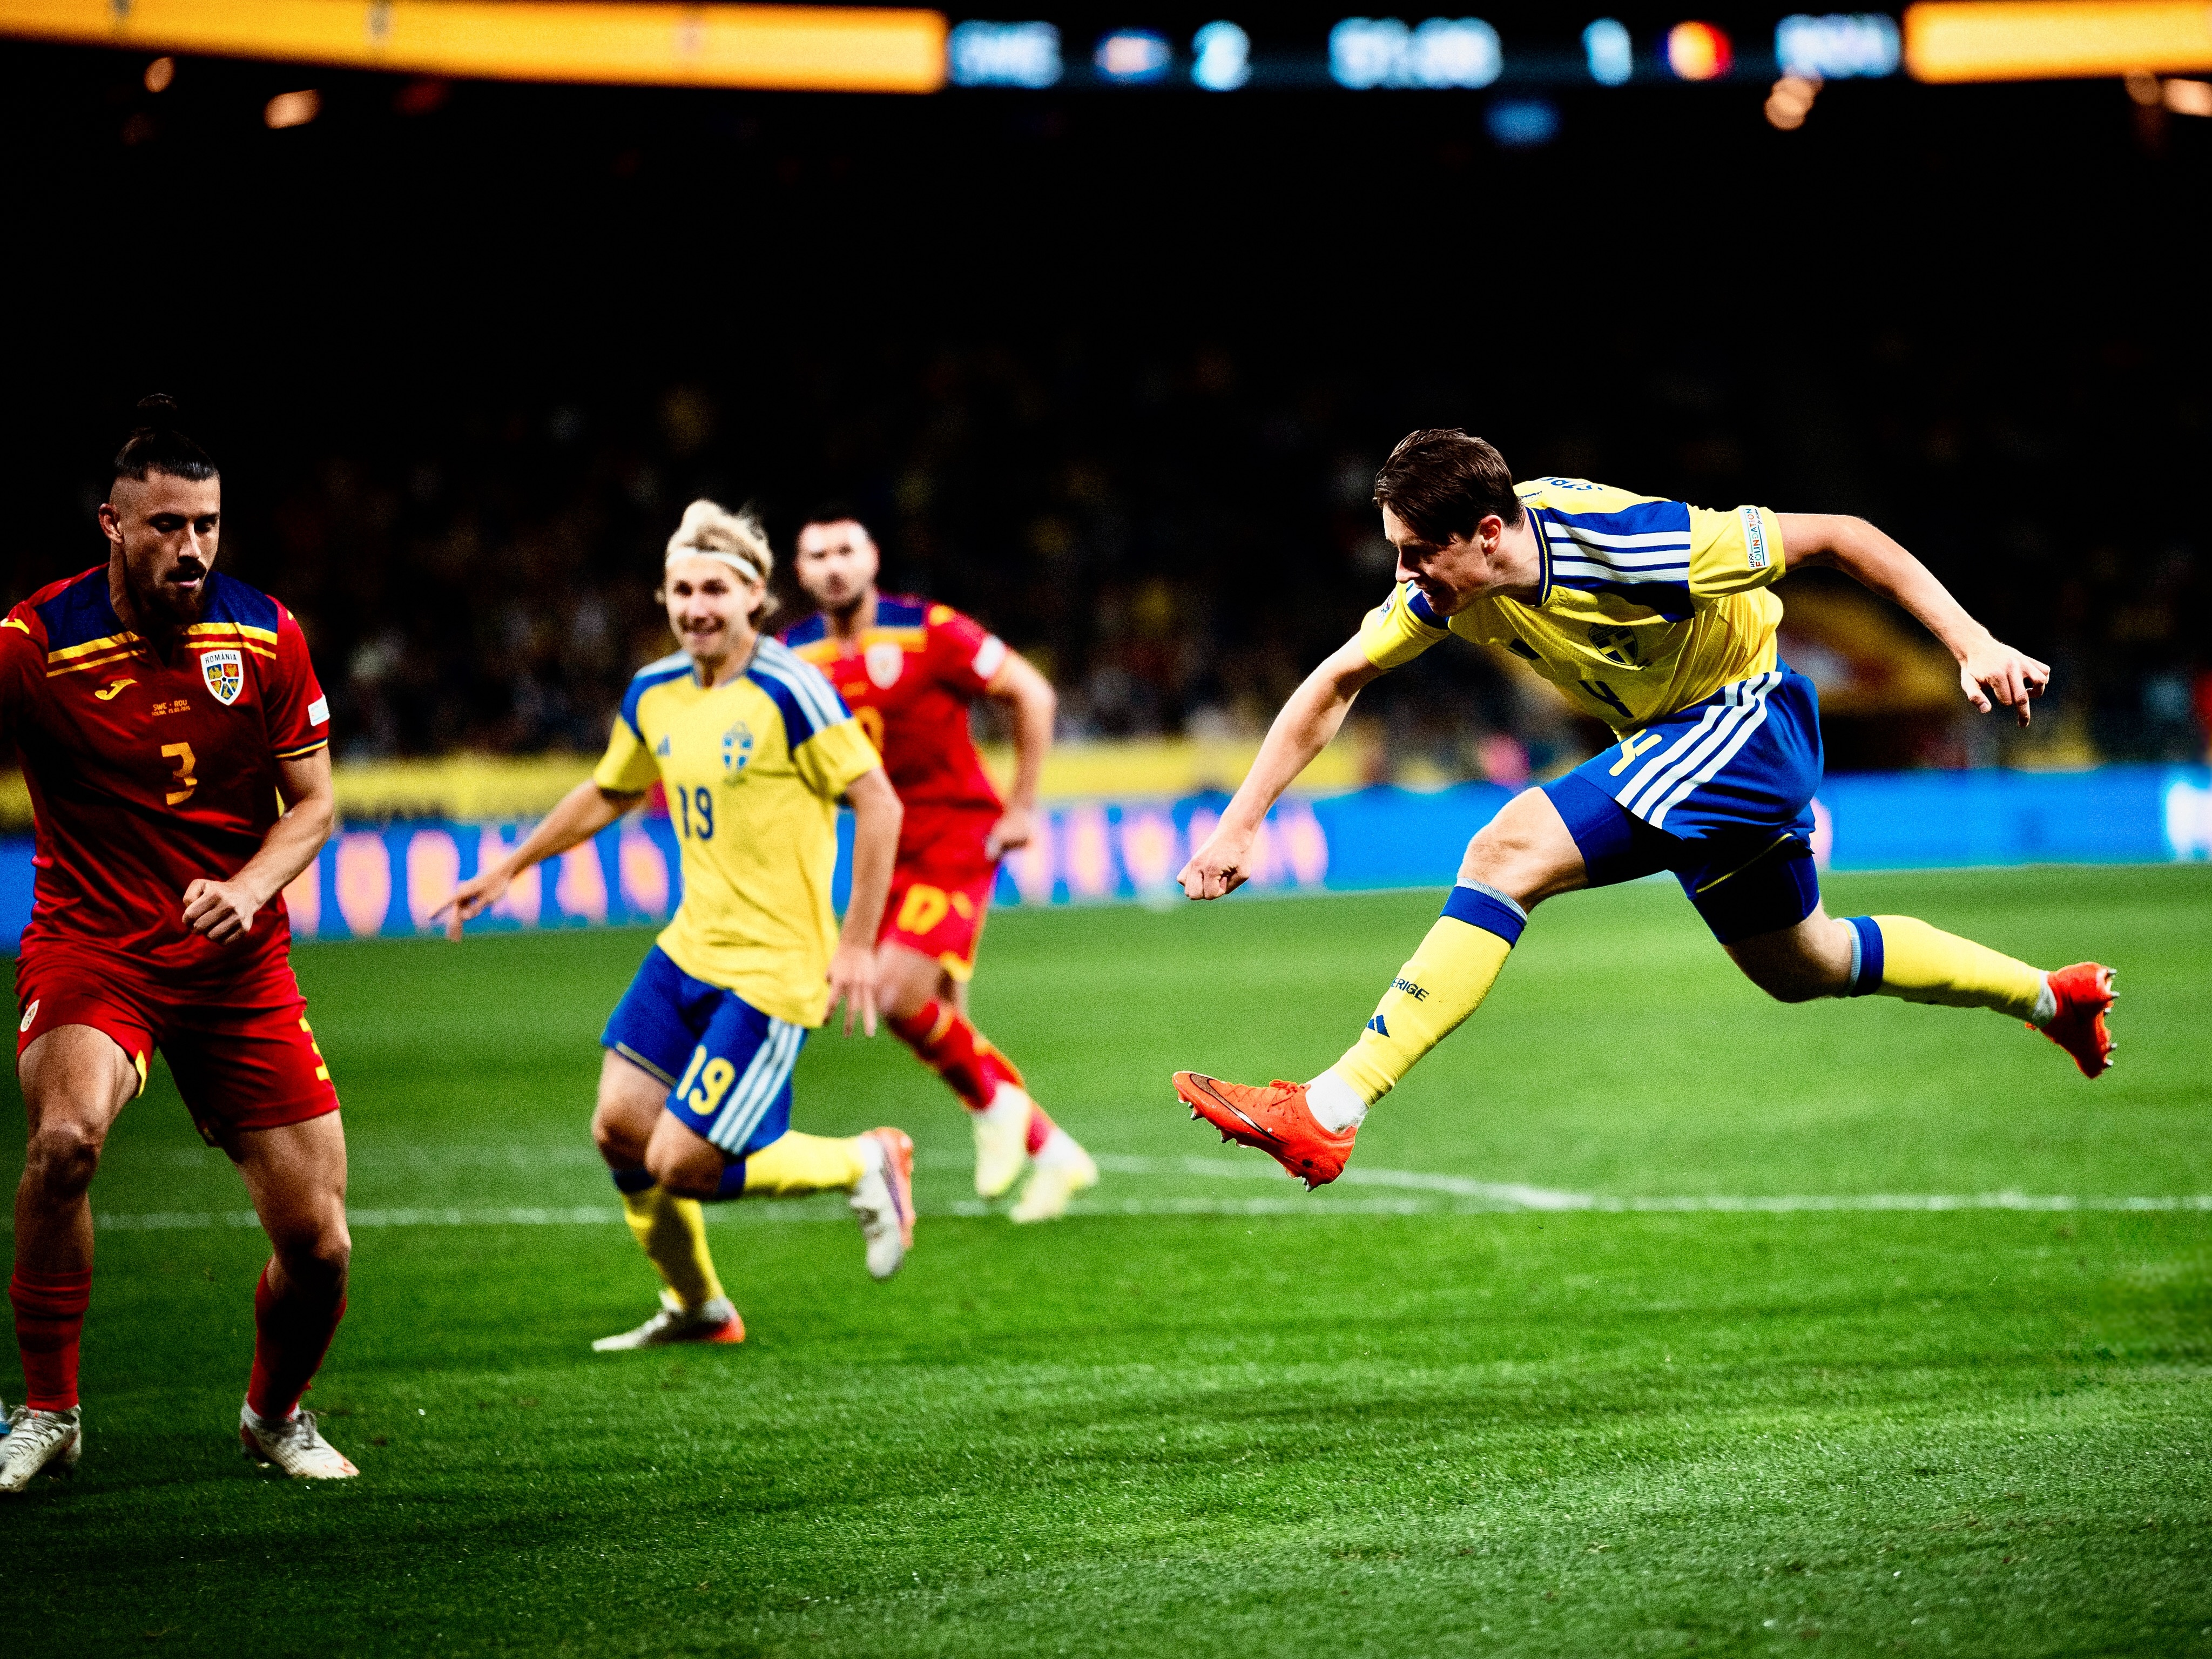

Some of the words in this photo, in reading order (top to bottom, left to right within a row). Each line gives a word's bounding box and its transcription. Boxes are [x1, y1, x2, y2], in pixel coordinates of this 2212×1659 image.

[1745, 509, 1763, 567] FOUNDATION
[1577, 680, 1634, 718] 4
[161, 743, 197, 805] 3
[1609, 729, 1662, 776] 4
[678, 785, 713, 841] 19
[1391, 977, 1429, 1002] ERIGE
[677, 1045, 736, 1115] 19
